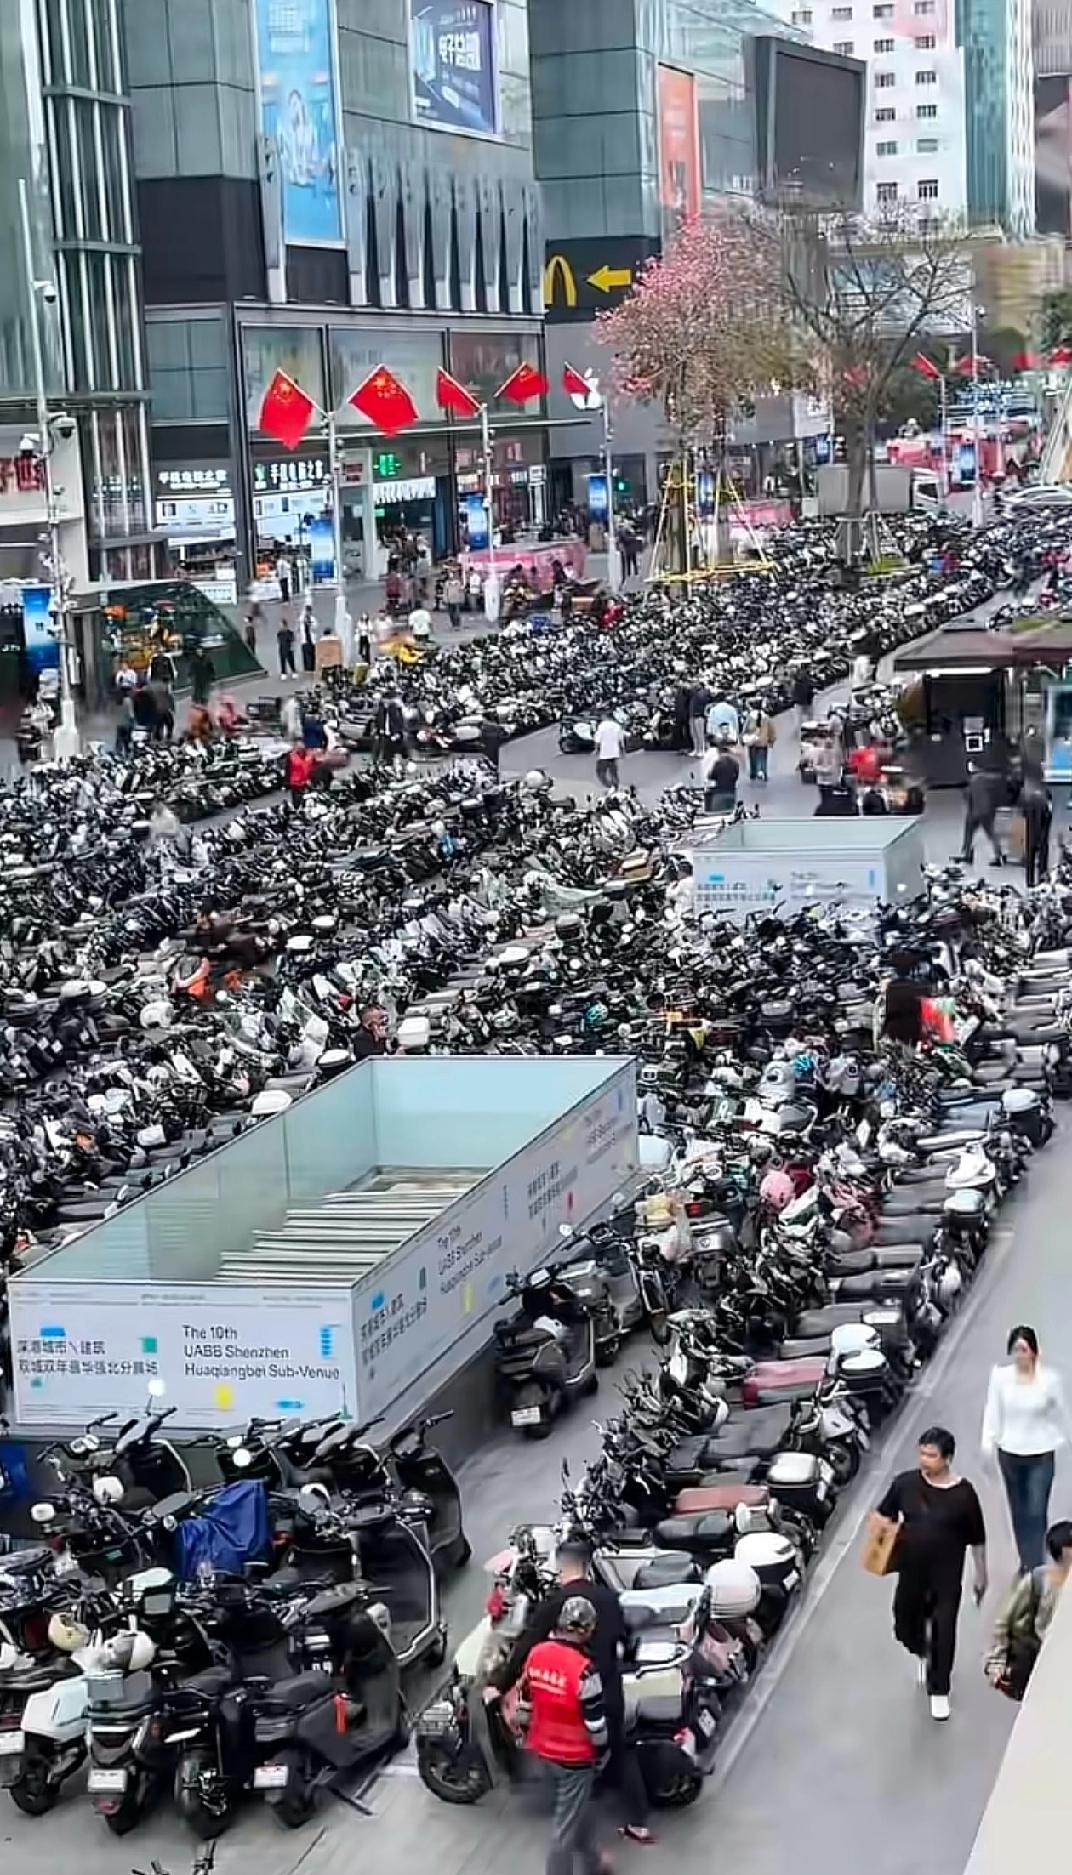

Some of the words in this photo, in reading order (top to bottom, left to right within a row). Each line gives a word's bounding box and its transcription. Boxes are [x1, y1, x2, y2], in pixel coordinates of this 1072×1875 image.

[182, 1325, 207, 1339] The
[210, 1325, 238, 1340] 10th
[184, 1345, 222, 1358] UABB
[225, 1345, 289, 1359] Shenzhen
[185, 1363, 266, 1381] Huaqiangbei
[268, 1364, 340, 1380] Sub-Venue
